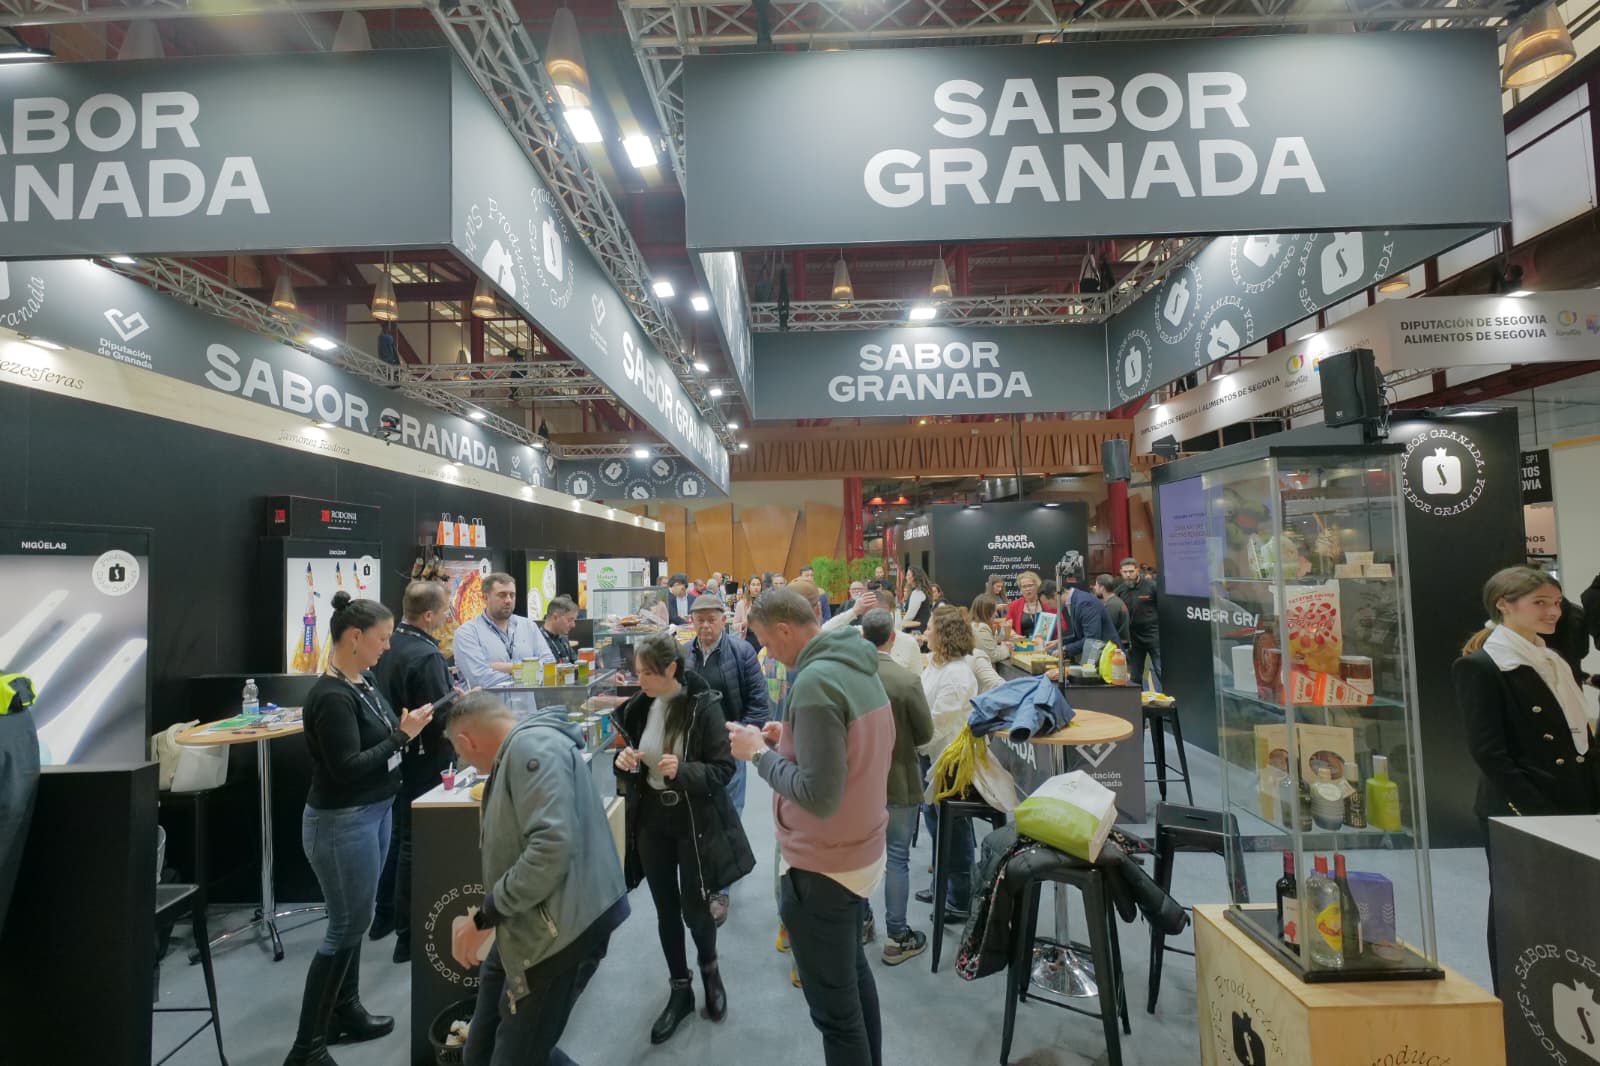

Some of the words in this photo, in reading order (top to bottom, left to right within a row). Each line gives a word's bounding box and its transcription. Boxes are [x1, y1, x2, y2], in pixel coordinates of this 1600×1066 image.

[0, 91, 200, 155] BOR
[933, 71, 1250, 140] SABOR
[0, 156, 270, 223] NADA
[864, 136, 1326, 208] GRANADA
[1298, 233, 1319, 277] SABO
[0, 276, 45, 327] ranada
[1401, 317, 1474, 331] DIPUTACIÓN
[1477, 317, 1492, 328] DE
[1495, 314, 1548, 327] SEGOVIA
[1404, 331, 1473, 344] ALIMENTOS
[1476, 330, 1492, 341] DE
[1494, 328, 1546, 340] SEGOVIA
[98, 347, 110, 357] de
[112, 350, 153, 370] Granada
[99, 337, 152, 360] Diputación
[858, 341, 1001, 371] SABOR
[0, 358, 84, 390] ezesferas
[204, 343, 369, 433] SABOR
[623, 331, 674, 424] SABOR
[828, 371, 1032, 402] GRANADA
[1202, 393, 1237, 411] ALIMENTOS
[1238, 387, 1247, 397] DE
[1248, 375, 1280, 393] SEGOVIA
[1430, 429, 1486, 468] GRANADA
[1433, 478, 1486, 516] GRANADA
[21, 540, 67, 550] NIGÜELAS
[987, 541, 1035, 550] GRANADA
[995, 534, 1027, 542] SABOR
[1187, 606, 1229, 625] SABOR
[1088, 771, 1121, 780] utación
[425, 887, 460, 932] SABOR
[425, 942, 461, 984] SABOR
[1515, 944, 1561, 980] SABOR
